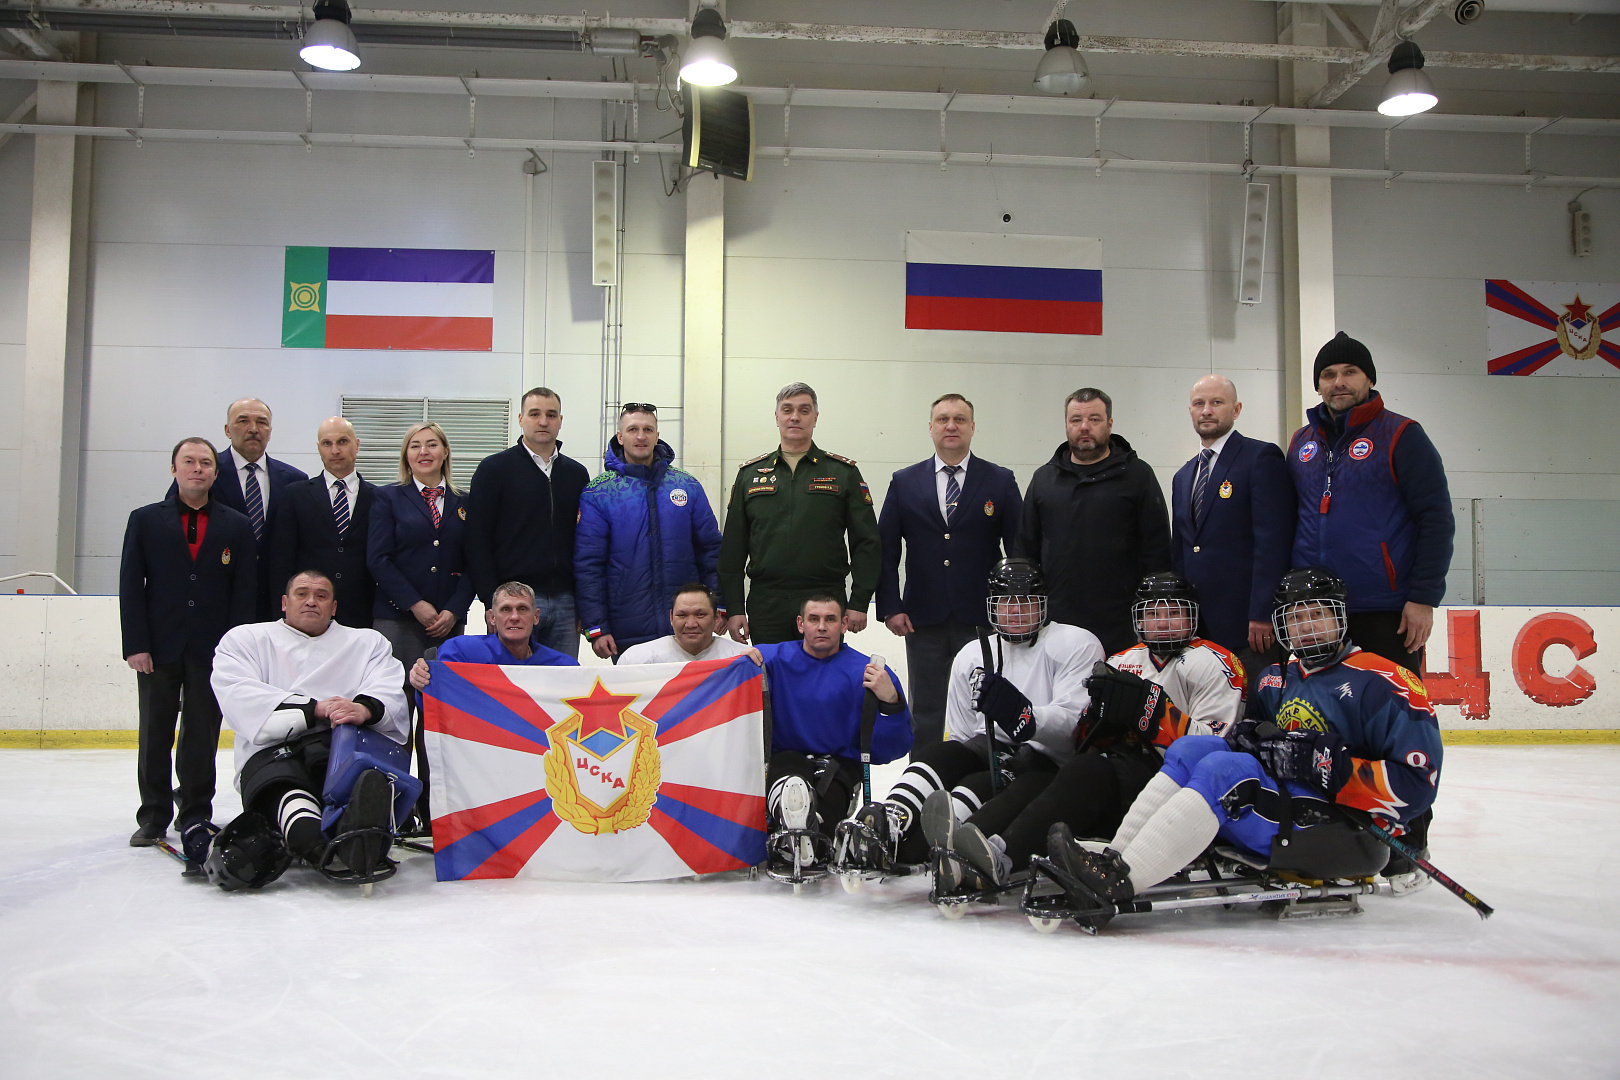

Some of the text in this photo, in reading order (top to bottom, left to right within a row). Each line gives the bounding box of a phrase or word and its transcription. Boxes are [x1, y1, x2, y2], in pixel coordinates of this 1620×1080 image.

[1569, 329, 1587, 342] ЦСКА
[1139, 684, 1161, 731] ESPO
[577, 758, 625, 788] ЦСКА
